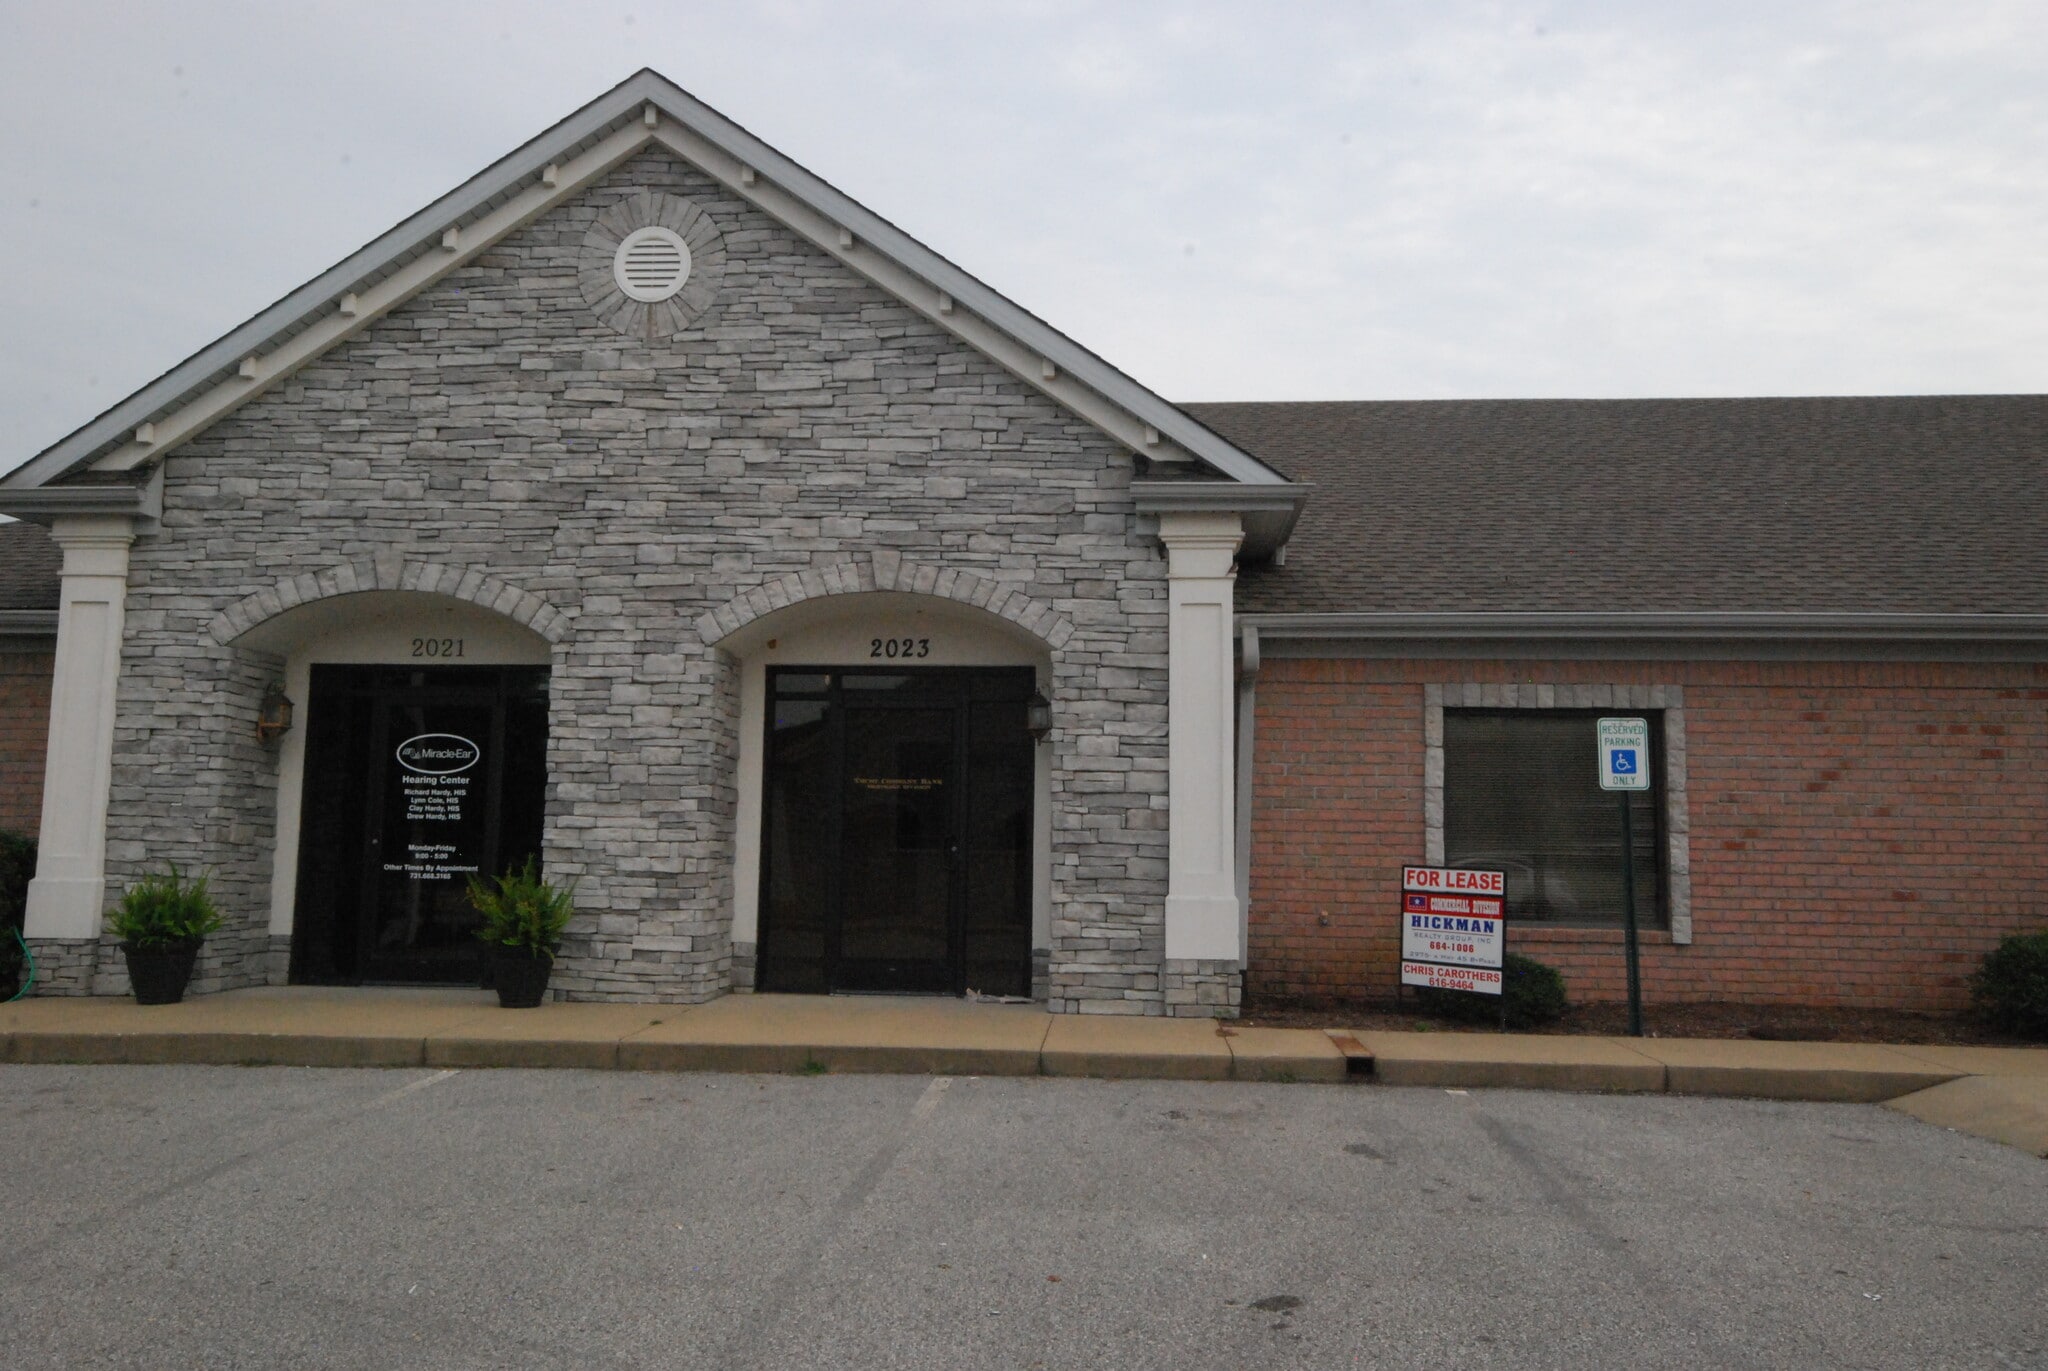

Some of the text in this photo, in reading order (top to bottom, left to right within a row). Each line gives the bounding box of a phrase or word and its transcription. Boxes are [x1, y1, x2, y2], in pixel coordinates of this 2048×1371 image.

[411, 638, 464, 657] 2021
[870, 638, 930, 658] 2023
[1602, 725, 1644, 735] RESERVED
[1604, 737, 1641, 747] PARKING
[422, 748, 472, 759] Miracle-Ear
[402, 775, 470, 786] Hearing Center
[1612, 776, 1636, 785] ONLY
[431, 789, 452, 797] Hardy,
[410, 797, 426, 805] Lynn
[408, 805, 424, 813] Clay
[425, 805, 446, 813] Hardy,
[408, 844, 456, 853] Monday-Friday
[425, 865, 434, 873] By
[435, 865, 478, 873] Appointment
[1407, 870, 1502, 890] FOR LEASE
[1412, 915, 1494, 933] HICKMAN
[1413, 932, 1441, 940] REALTY
[1430, 942, 1474, 952] 664-1006
[1404, 965, 1500, 982] CHRIS CAROTHERS
[1429, 978, 1474, 990] 616-9464
